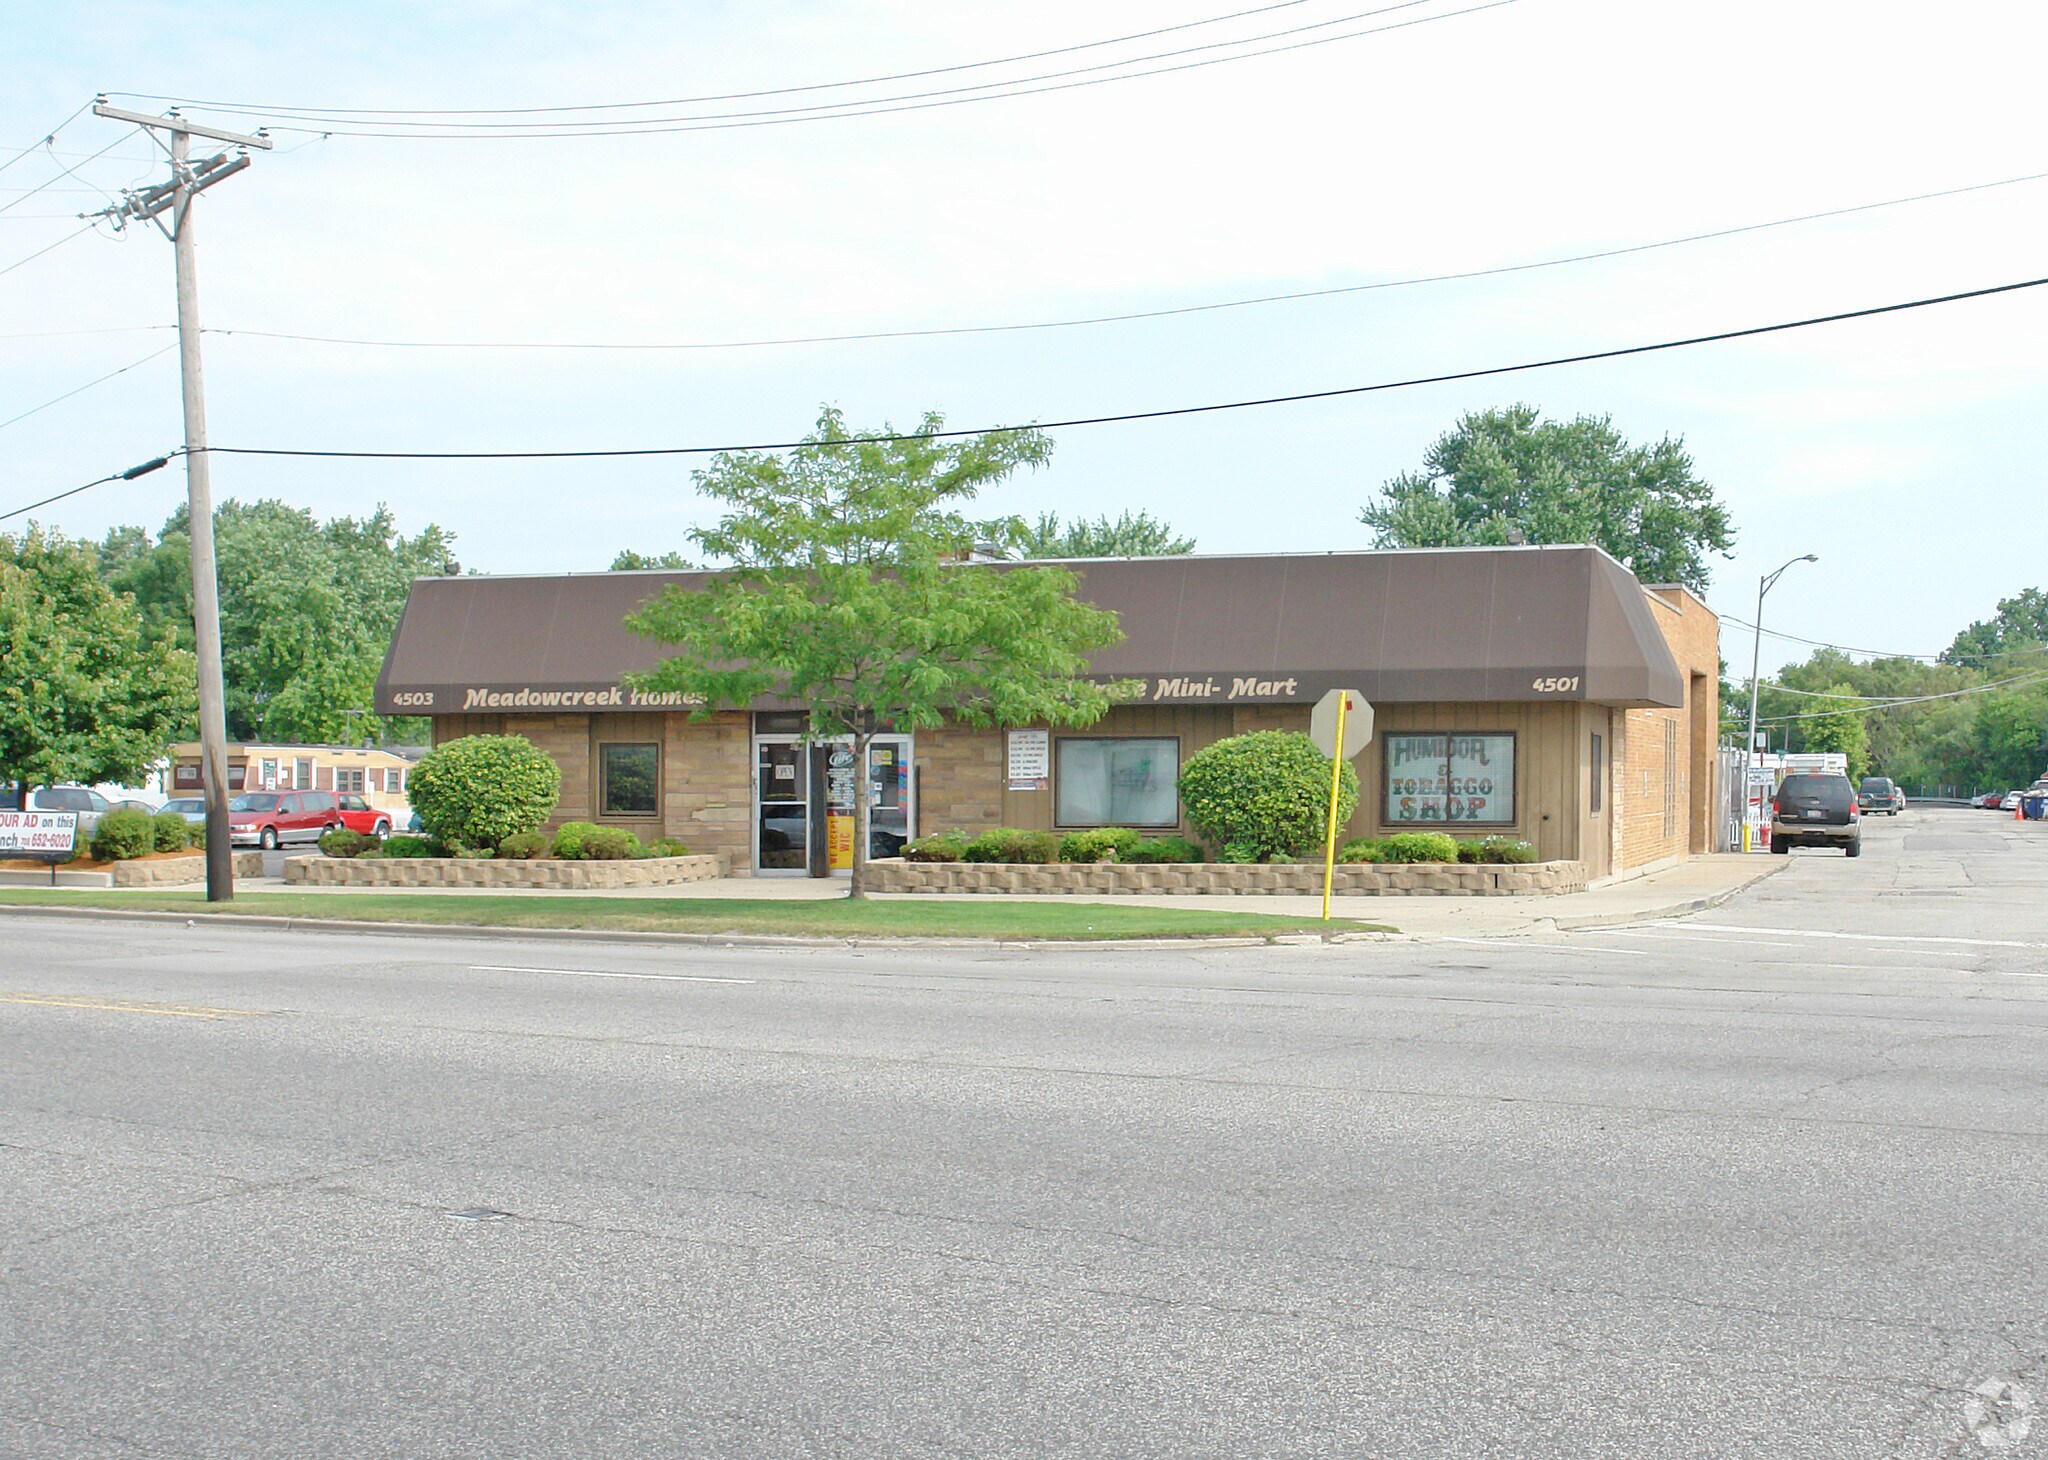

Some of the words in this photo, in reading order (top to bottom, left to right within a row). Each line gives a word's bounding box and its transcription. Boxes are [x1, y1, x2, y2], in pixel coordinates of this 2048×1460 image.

[1228, 677, 1298, 700] Mart
[1532, 676, 1579, 692] 4501
[392, 691, 434, 706] 4503
[463, 687, 623, 710] Meadowcreek
[1394, 738, 1490, 767] HUMIDOR
[1399, 796, 1487, 820] SHOP
[23, 814, 38, 828] AD
[42, 818, 53, 828] on
[57, 815, 74, 828] this
[840, 832, 850, 852] WIC
